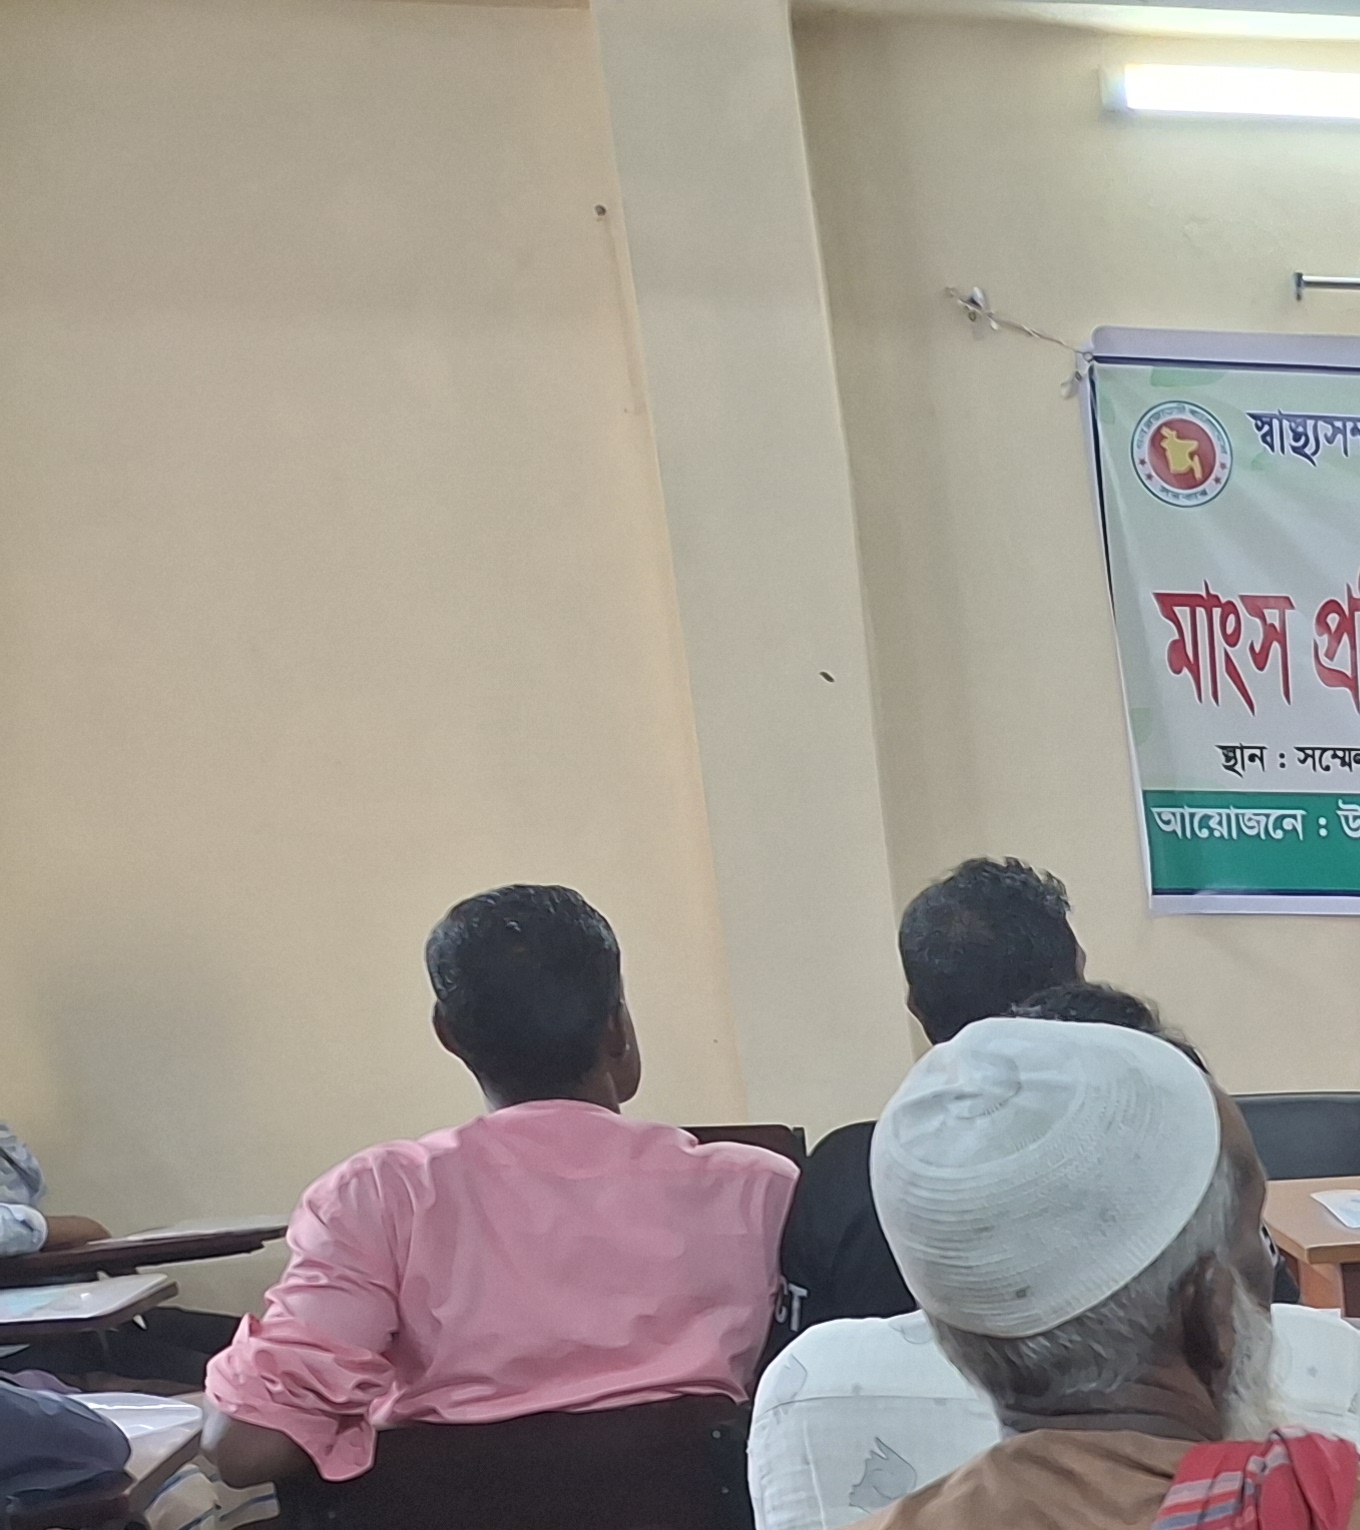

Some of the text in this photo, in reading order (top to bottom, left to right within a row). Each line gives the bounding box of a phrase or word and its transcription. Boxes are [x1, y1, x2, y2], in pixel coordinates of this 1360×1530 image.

[1153, 579, 1295, 716] মাংস
[1215, 742, 1268, 779] স্থান
[1150, 804, 1307, 841] আয়োজনে
